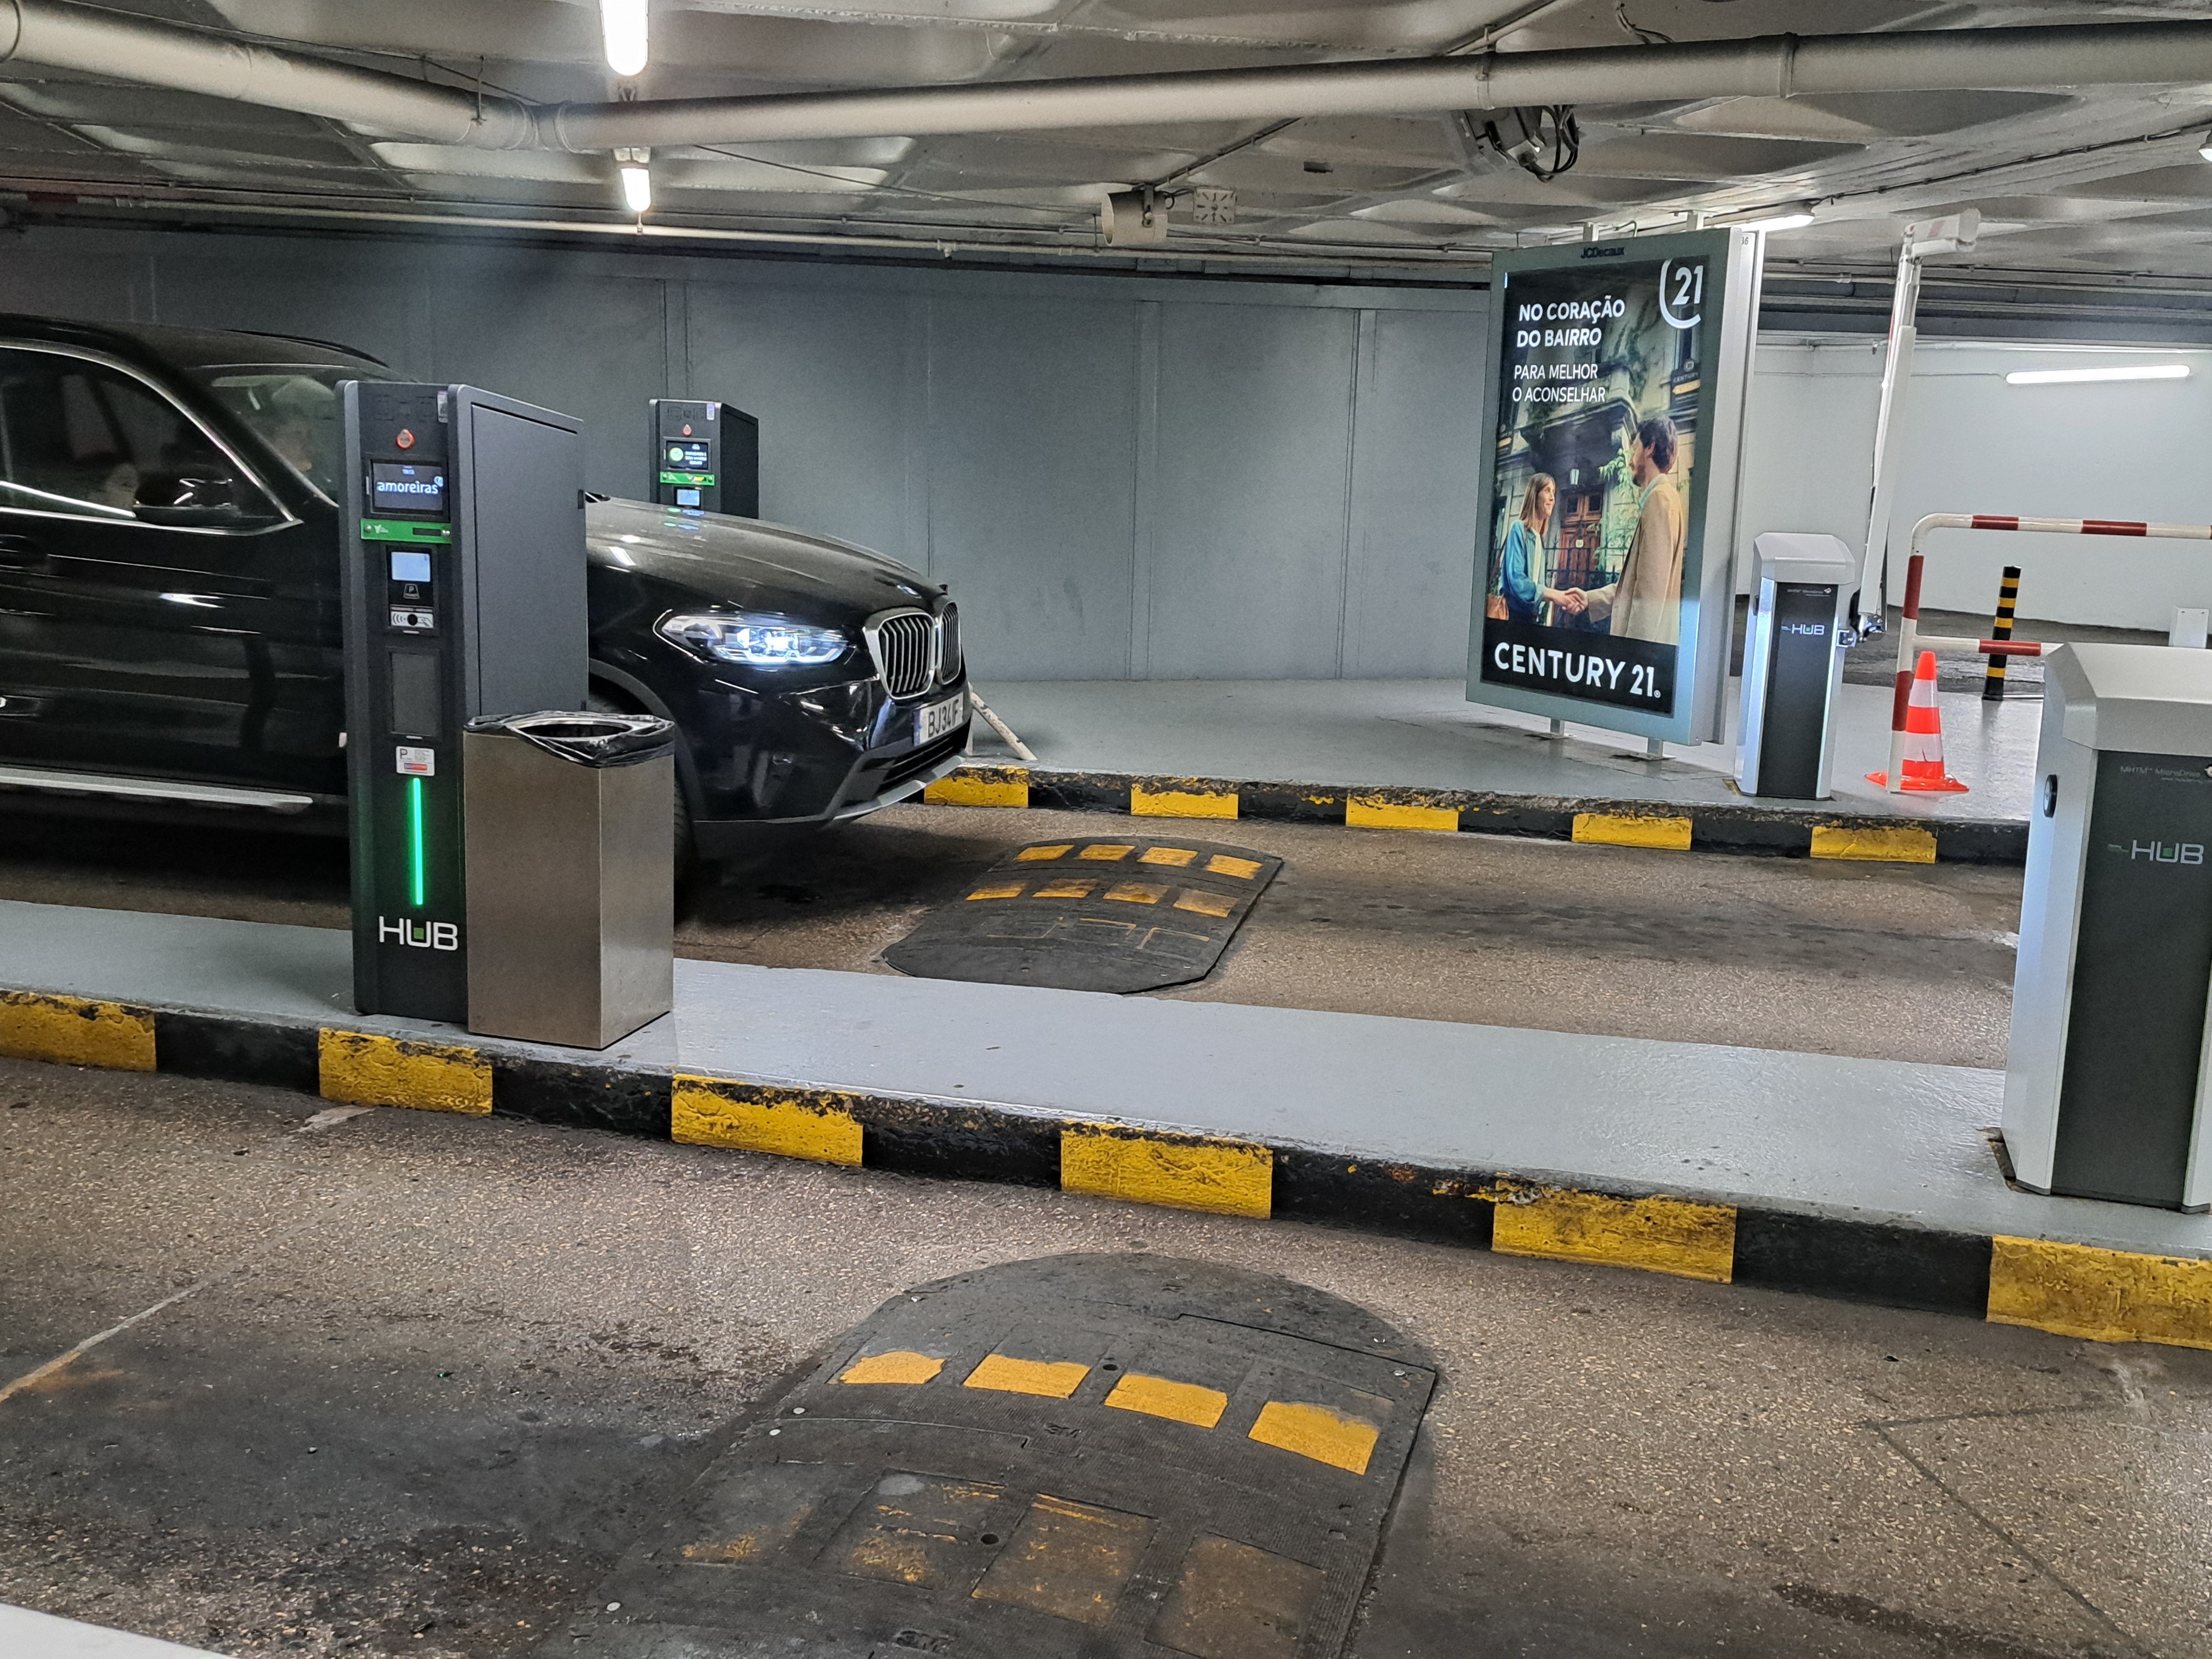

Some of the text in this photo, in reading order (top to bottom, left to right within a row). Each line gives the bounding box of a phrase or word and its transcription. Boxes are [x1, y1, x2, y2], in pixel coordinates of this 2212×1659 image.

[1519, 295, 1625, 324] NO CORAÇÃO
[1516, 327, 1602, 347] DO BAIRRO
[1514, 363, 1598, 379] PARA MELHOR
[1512, 386, 1605, 403] O ACONSELHAR
[376, 480, 439, 494] amoreiras
[1791, 623, 1825, 635] HUB
[1494, 642, 1626, 690] CENTURY
[400, 748, 408, 760] P
[2130, 839, 2204, 865] HUB
[379, 916, 458, 951] HUB
